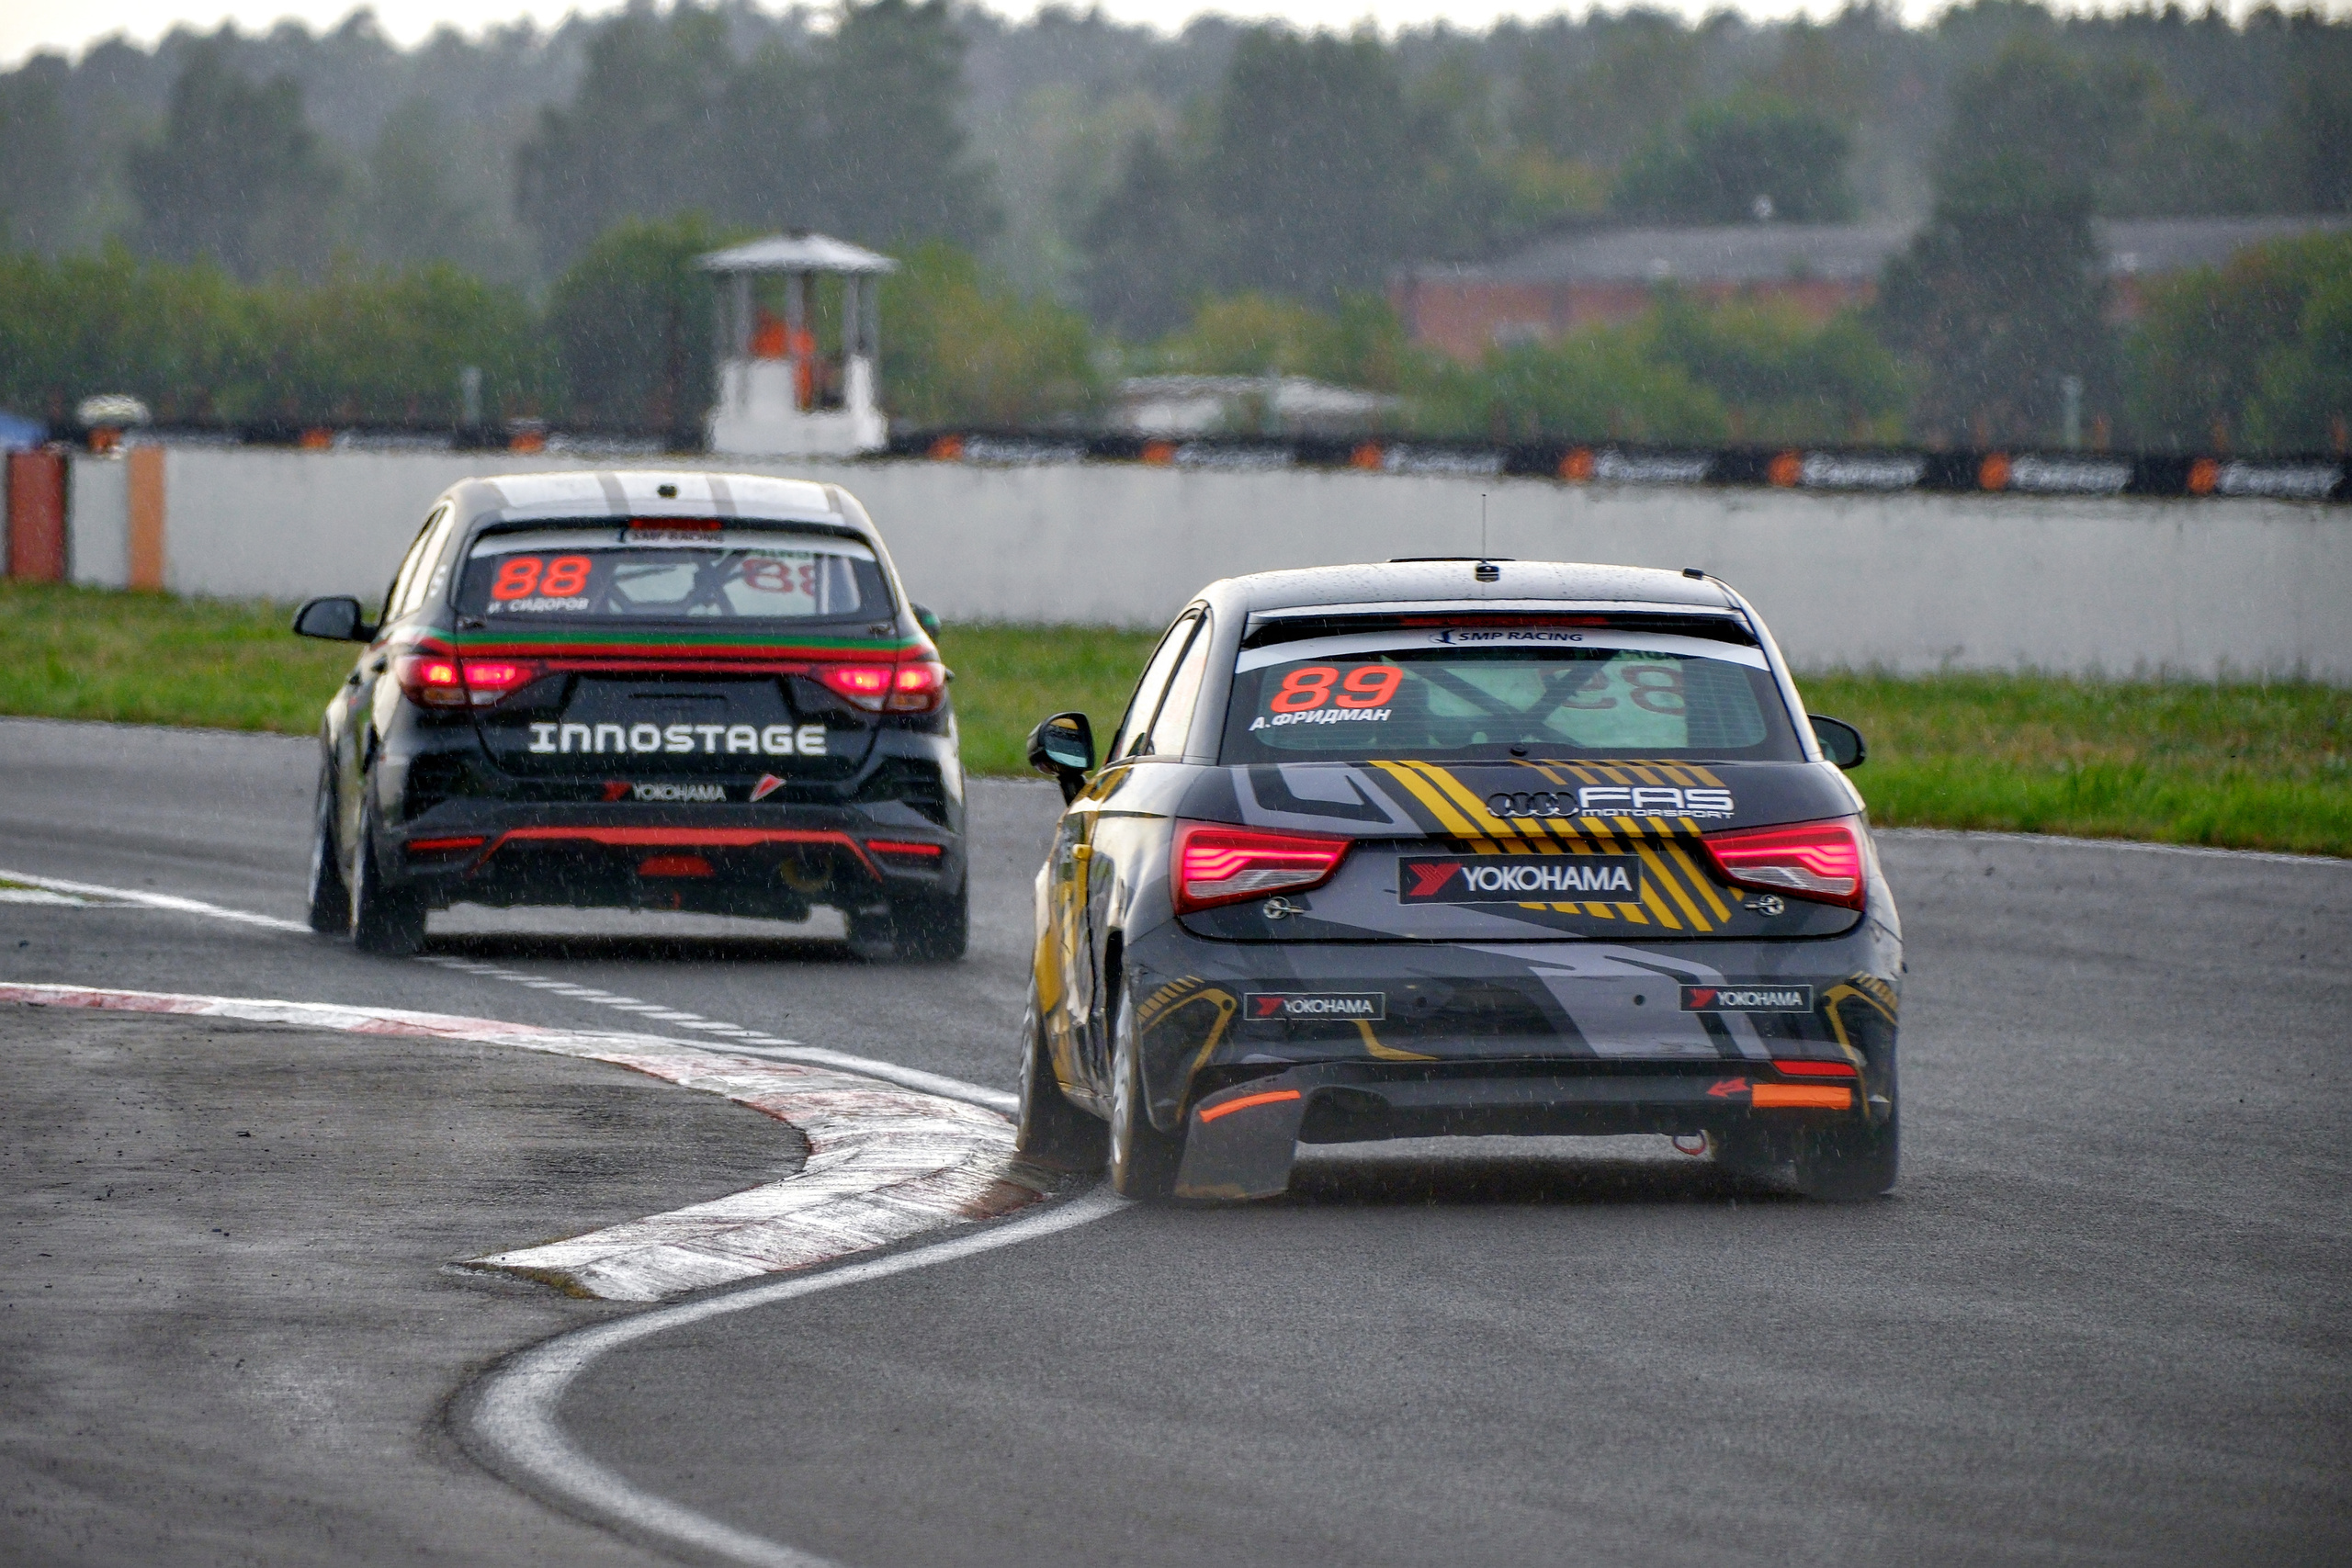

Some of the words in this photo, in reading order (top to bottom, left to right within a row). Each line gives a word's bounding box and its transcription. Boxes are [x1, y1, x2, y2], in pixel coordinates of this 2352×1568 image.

[492, 555, 592, 601] 88
[1458, 631, 1501, 641] SMP
[1507, 631, 1583, 642] RACING
[1271, 666, 1403, 713] 89
[1250, 709, 1392, 731] А.ФРИДМАН
[529, 723, 826, 755] INNOSTAGE
[632, 784, 727, 802] YOKOHAMA
[1578, 786, 1736, 811] FAS
[1581, 809, 1736, 819] MOTORSPORT
[1461, 866, 1633, 891] YOKOHAMA
[1283, 999, 1374, 1013] YOKOHAMA
[1716, 991, 1803, 1006] YOKOHAMA
